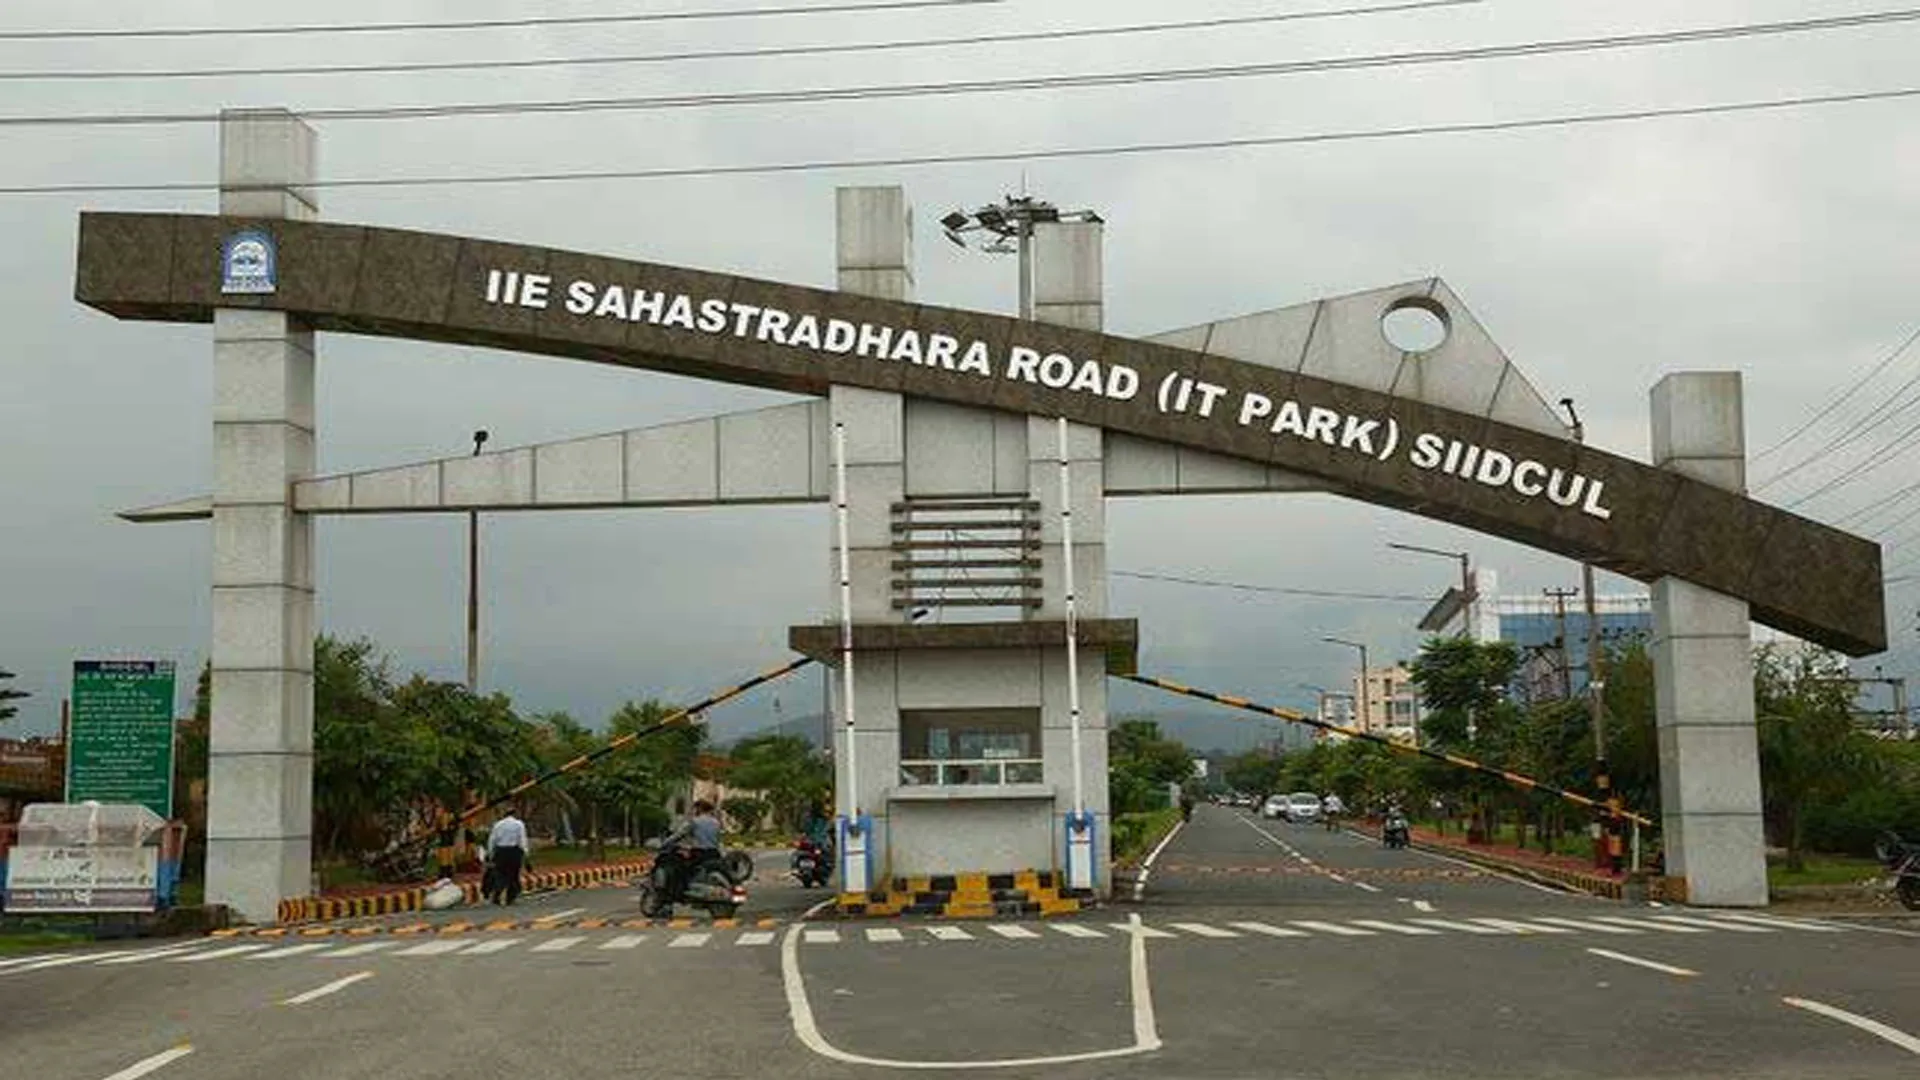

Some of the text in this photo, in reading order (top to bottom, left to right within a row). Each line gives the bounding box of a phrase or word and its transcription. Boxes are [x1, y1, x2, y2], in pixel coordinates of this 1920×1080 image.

[486, 270, 1611, 519] IIE SAHASTRADHARA ROAD (IT PARK) SIIDCUL
